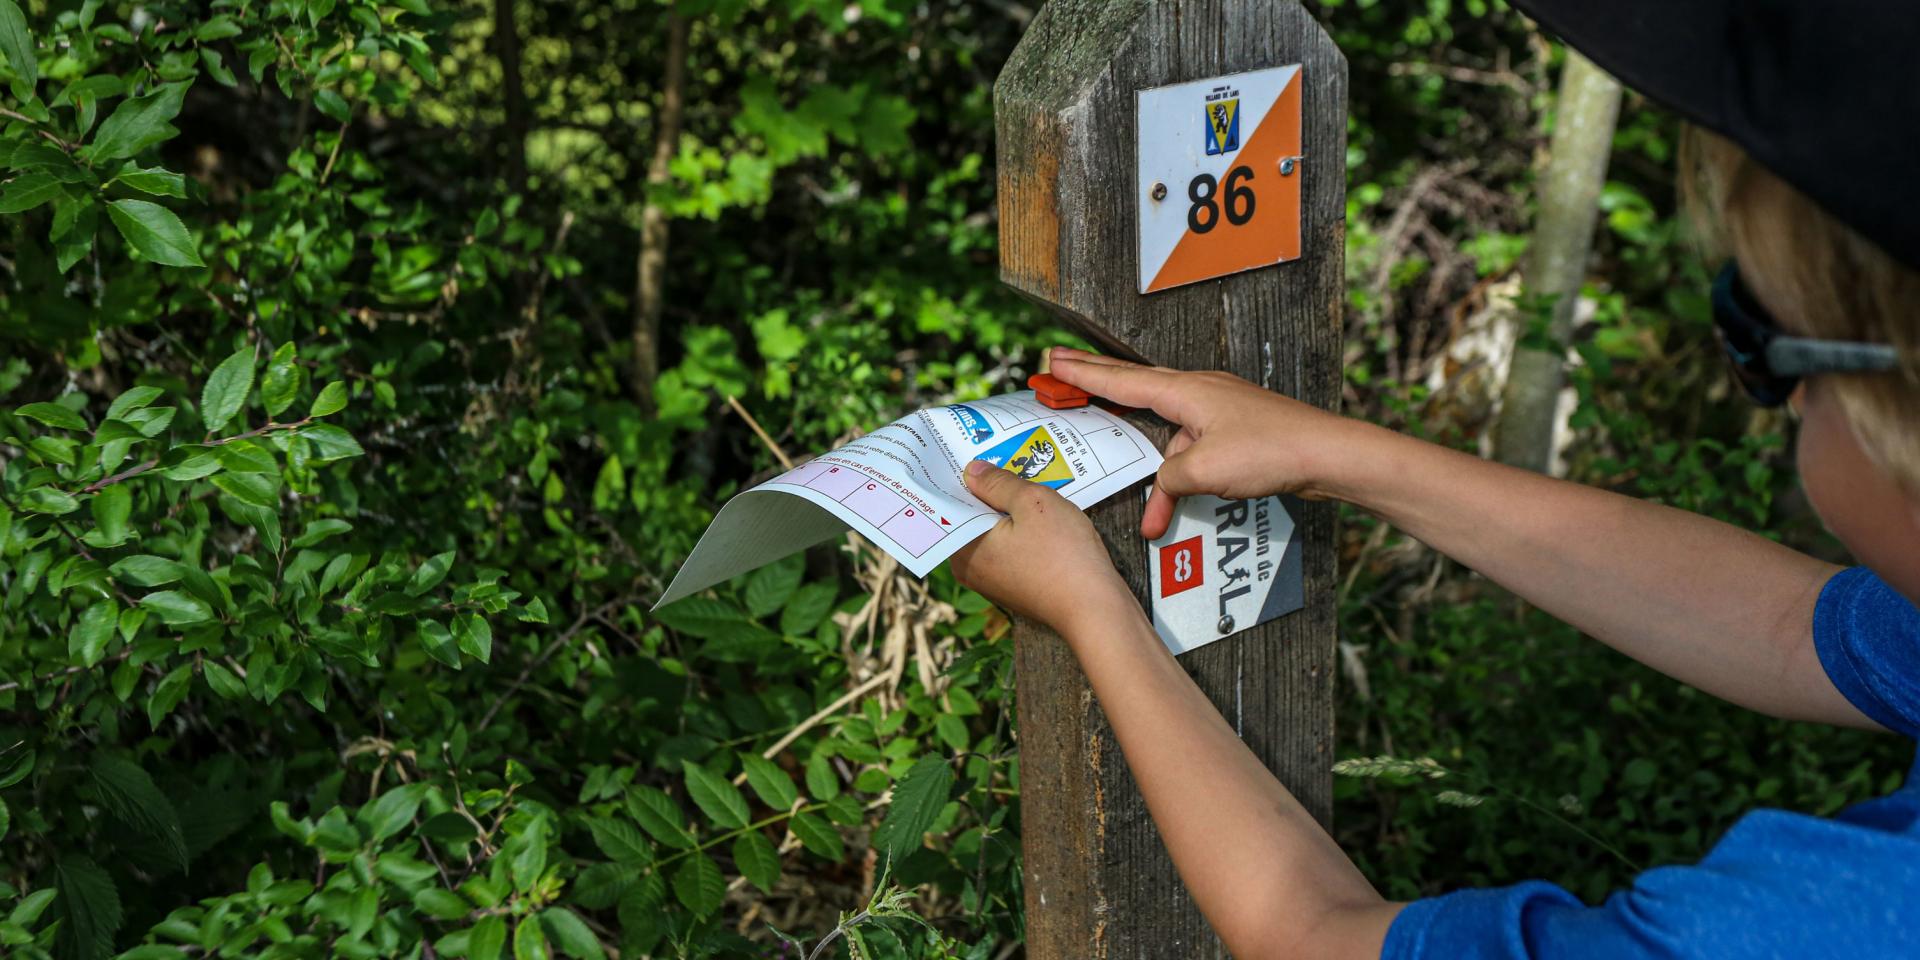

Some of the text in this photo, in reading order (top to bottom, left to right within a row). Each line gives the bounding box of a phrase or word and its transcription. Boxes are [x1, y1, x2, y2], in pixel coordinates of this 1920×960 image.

[1188, 166, 1255, 234] 86
[1065, 428, 1082, 448] COMMUNE
[1111, 428, 1123, 437] 10
[1047, 421, 1088, 476] VILLARD DE LANS
[851, 461, 862, 469] cas
[863, 466, 892, 483] d'erreur
[891, 480, 902, 490] de
[900, 488, 936, 515] pointage
[867, 483, 876, 491] C
[904, 509, 914, 517] D
[1174, 549, 1193, 583] 8
[1257, 560, 1273, 581] de
